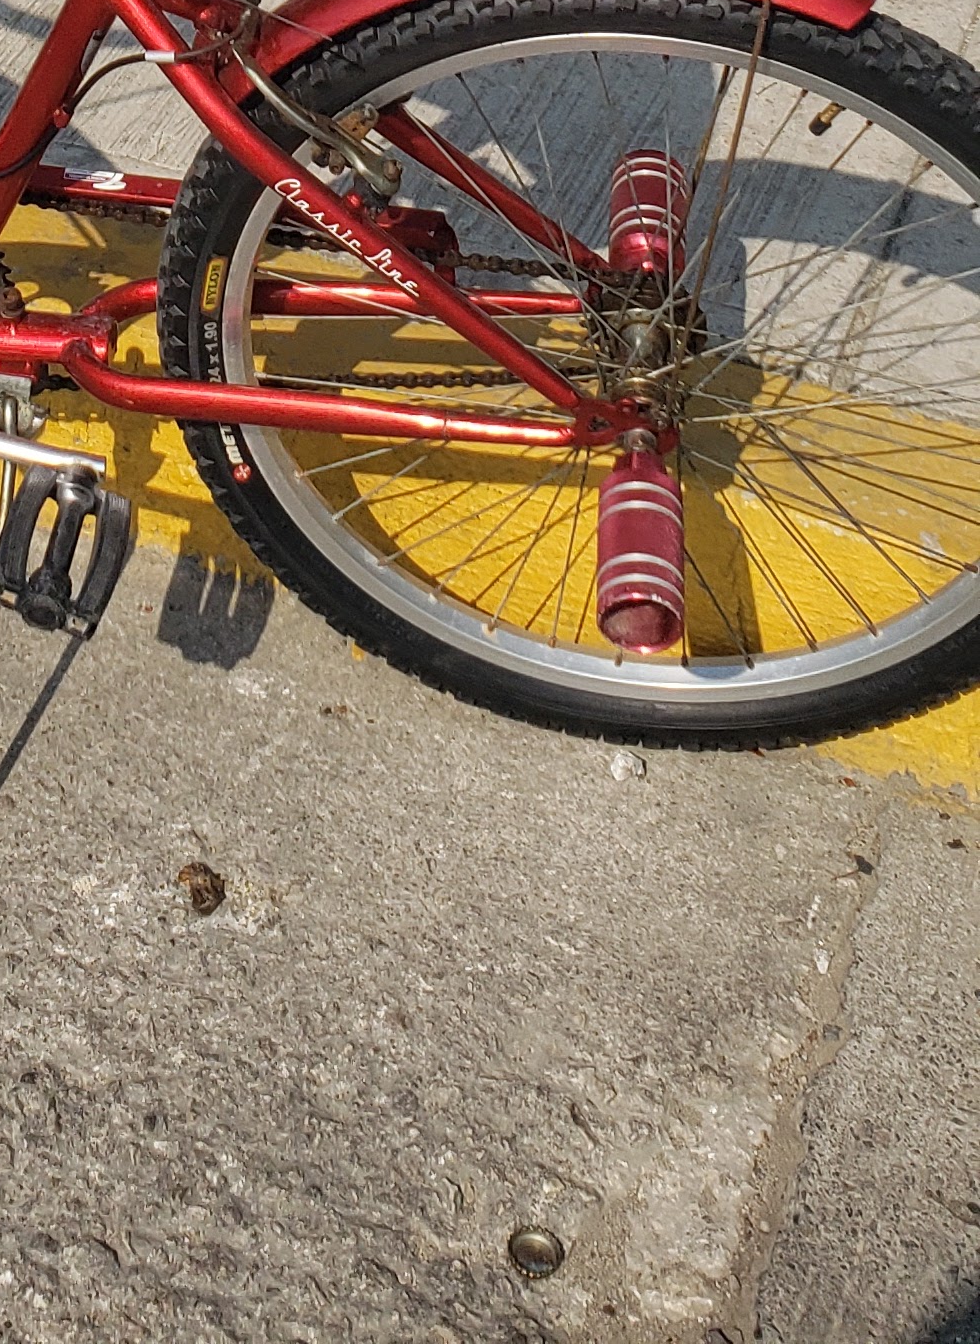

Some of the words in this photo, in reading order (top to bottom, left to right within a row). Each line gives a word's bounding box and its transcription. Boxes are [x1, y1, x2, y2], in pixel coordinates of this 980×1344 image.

[274, 178, 363, 256] Classic
[364, 248, 419, 297] Line
[205, 264, 221, 305] NYLON
[203, 321, 218, 351] 1.90
[218, 421, 244, 464] MET
